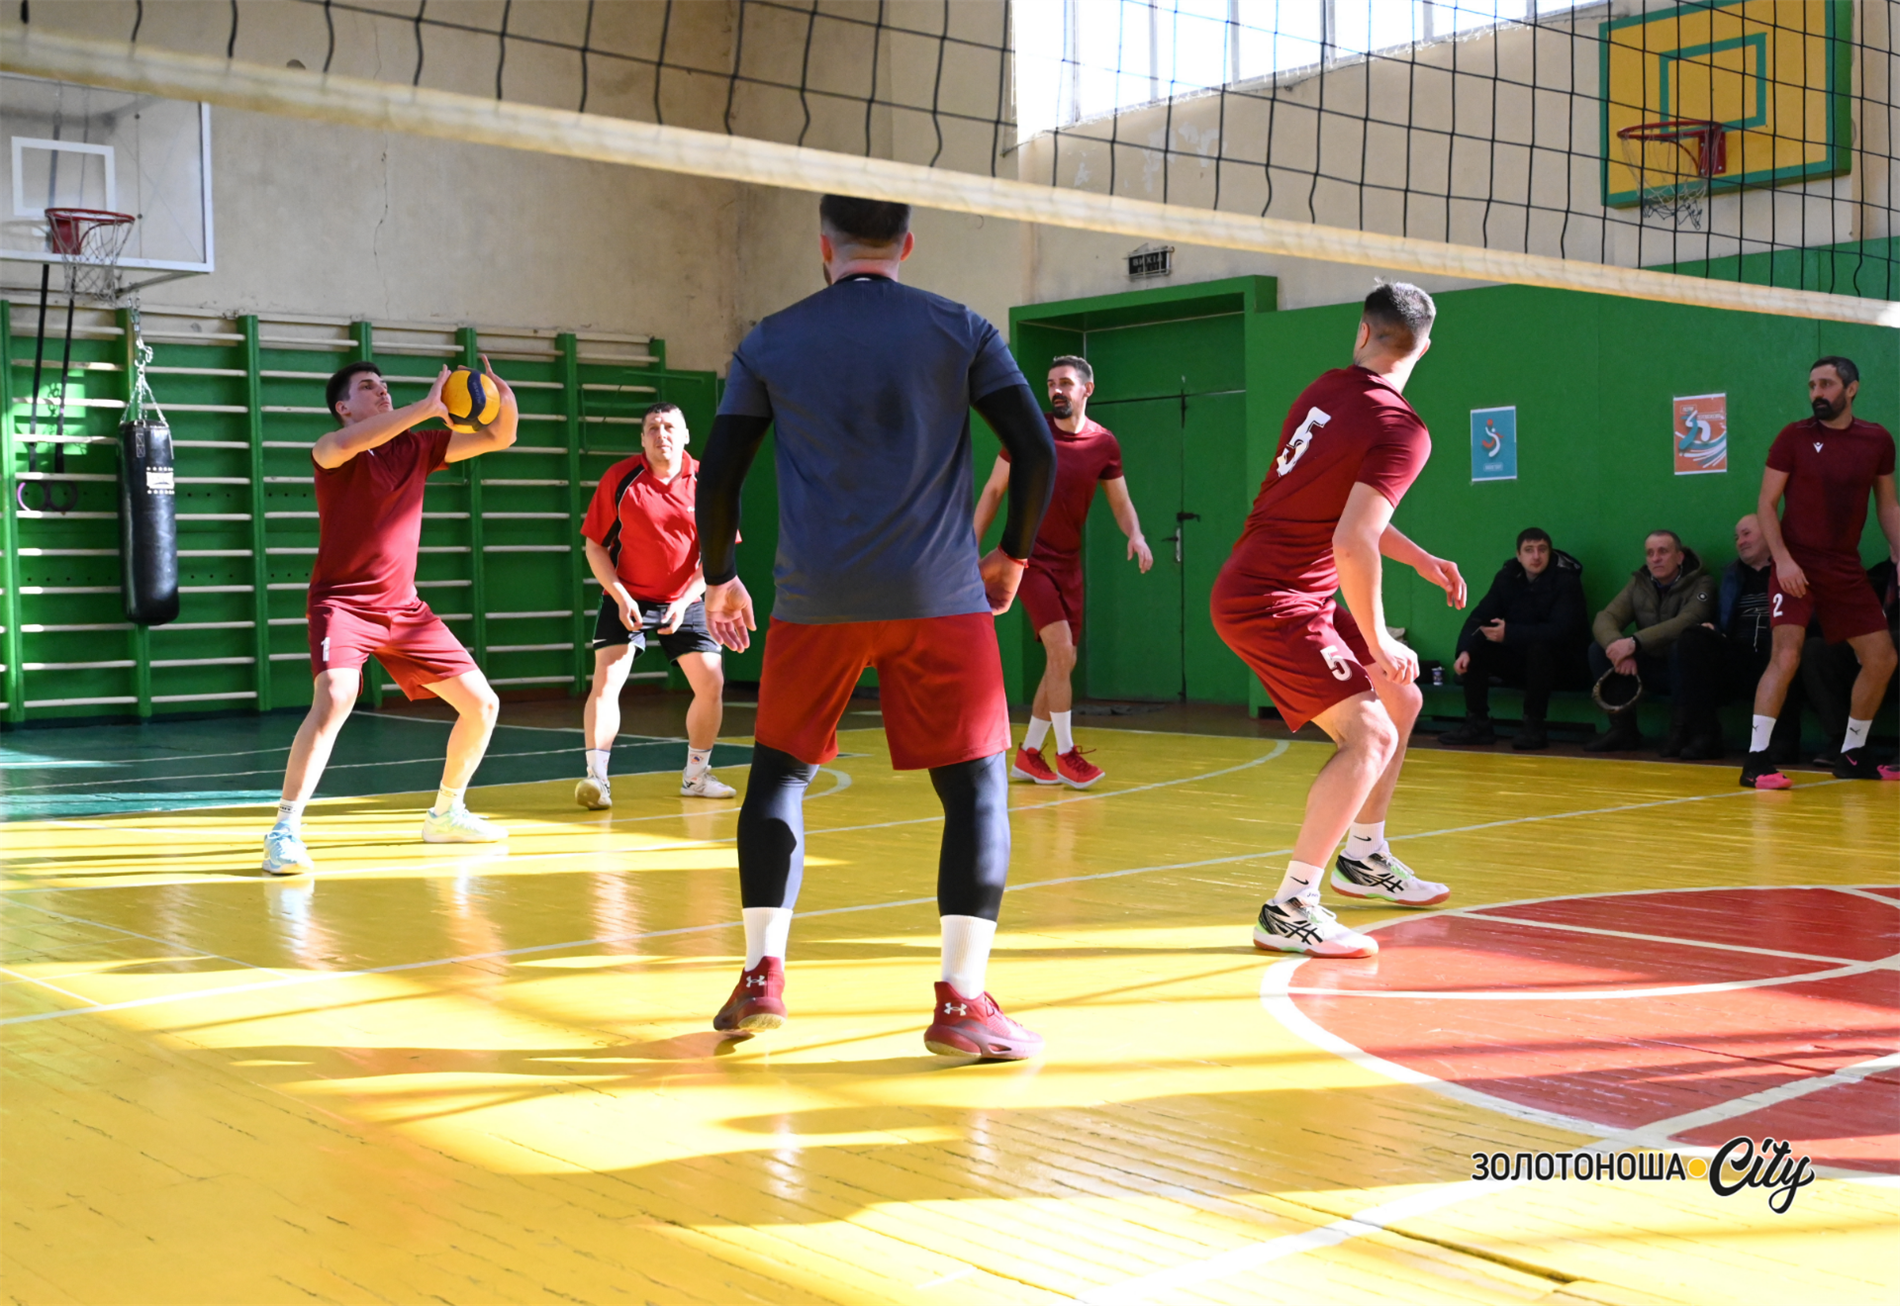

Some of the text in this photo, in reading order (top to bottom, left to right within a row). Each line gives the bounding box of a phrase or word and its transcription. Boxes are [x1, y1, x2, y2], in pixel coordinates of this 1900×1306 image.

[1277, 406, 1332, 477] 5
[1773, 593, 1783, 617] 2
[320, 636, 330, 662] 1
[1320, 645, 1352, 681] 5
